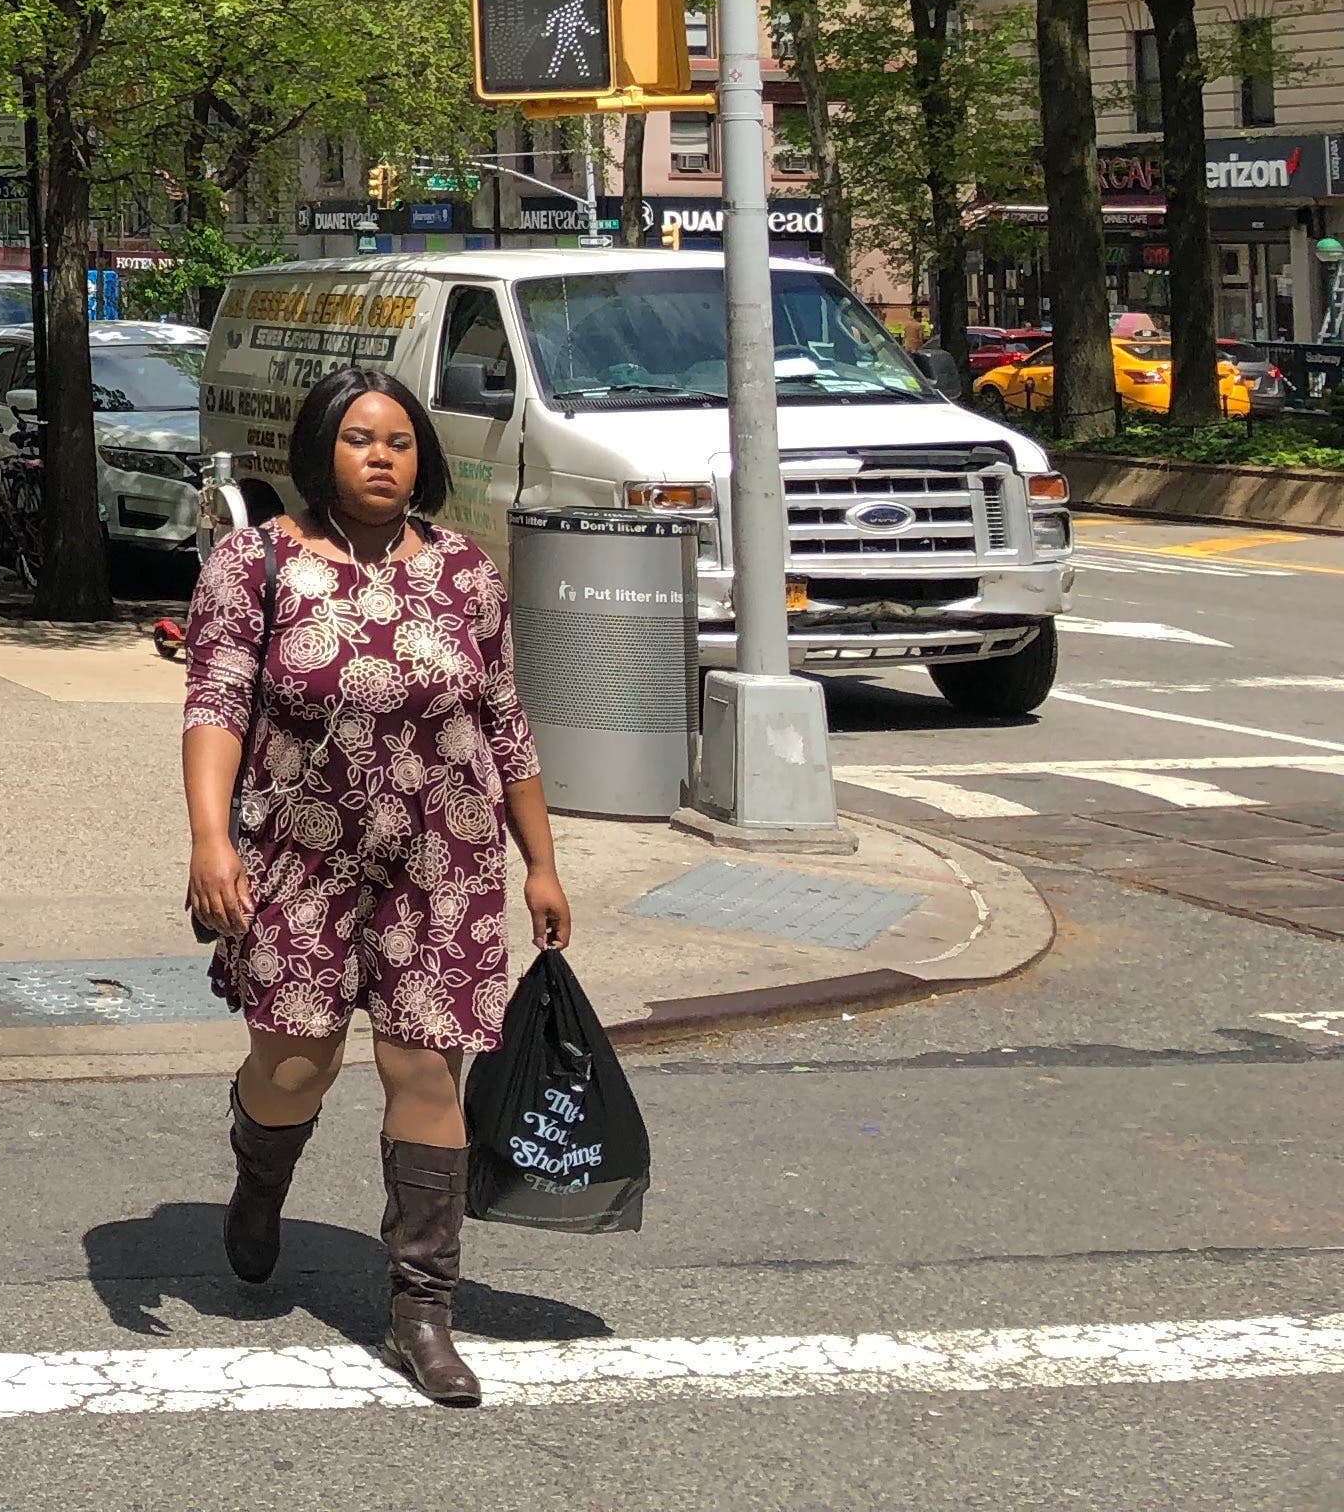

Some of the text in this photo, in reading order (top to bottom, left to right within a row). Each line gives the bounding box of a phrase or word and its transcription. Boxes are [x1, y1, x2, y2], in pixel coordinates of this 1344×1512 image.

[1206, 152, 1290, 189] erizon
[1330, 139, 1341, 180] verizon
[768, 207, 824, 233] ead
[368, 294, 417, 330] CORP.
[350, 336, 390, 357] CEANED
[238, 390, 291, 422] RECYCLING
[525, 515, 549, 528] litter
[580, 519, 648, 533] Don't litter
[584, 586, 611, 600] Put
[615, 587, 652, 603] litter
[655, 589, 668, 603] in
[670, 590, 683, 604] its
[509, 1136, 602, 1176] Shoping
